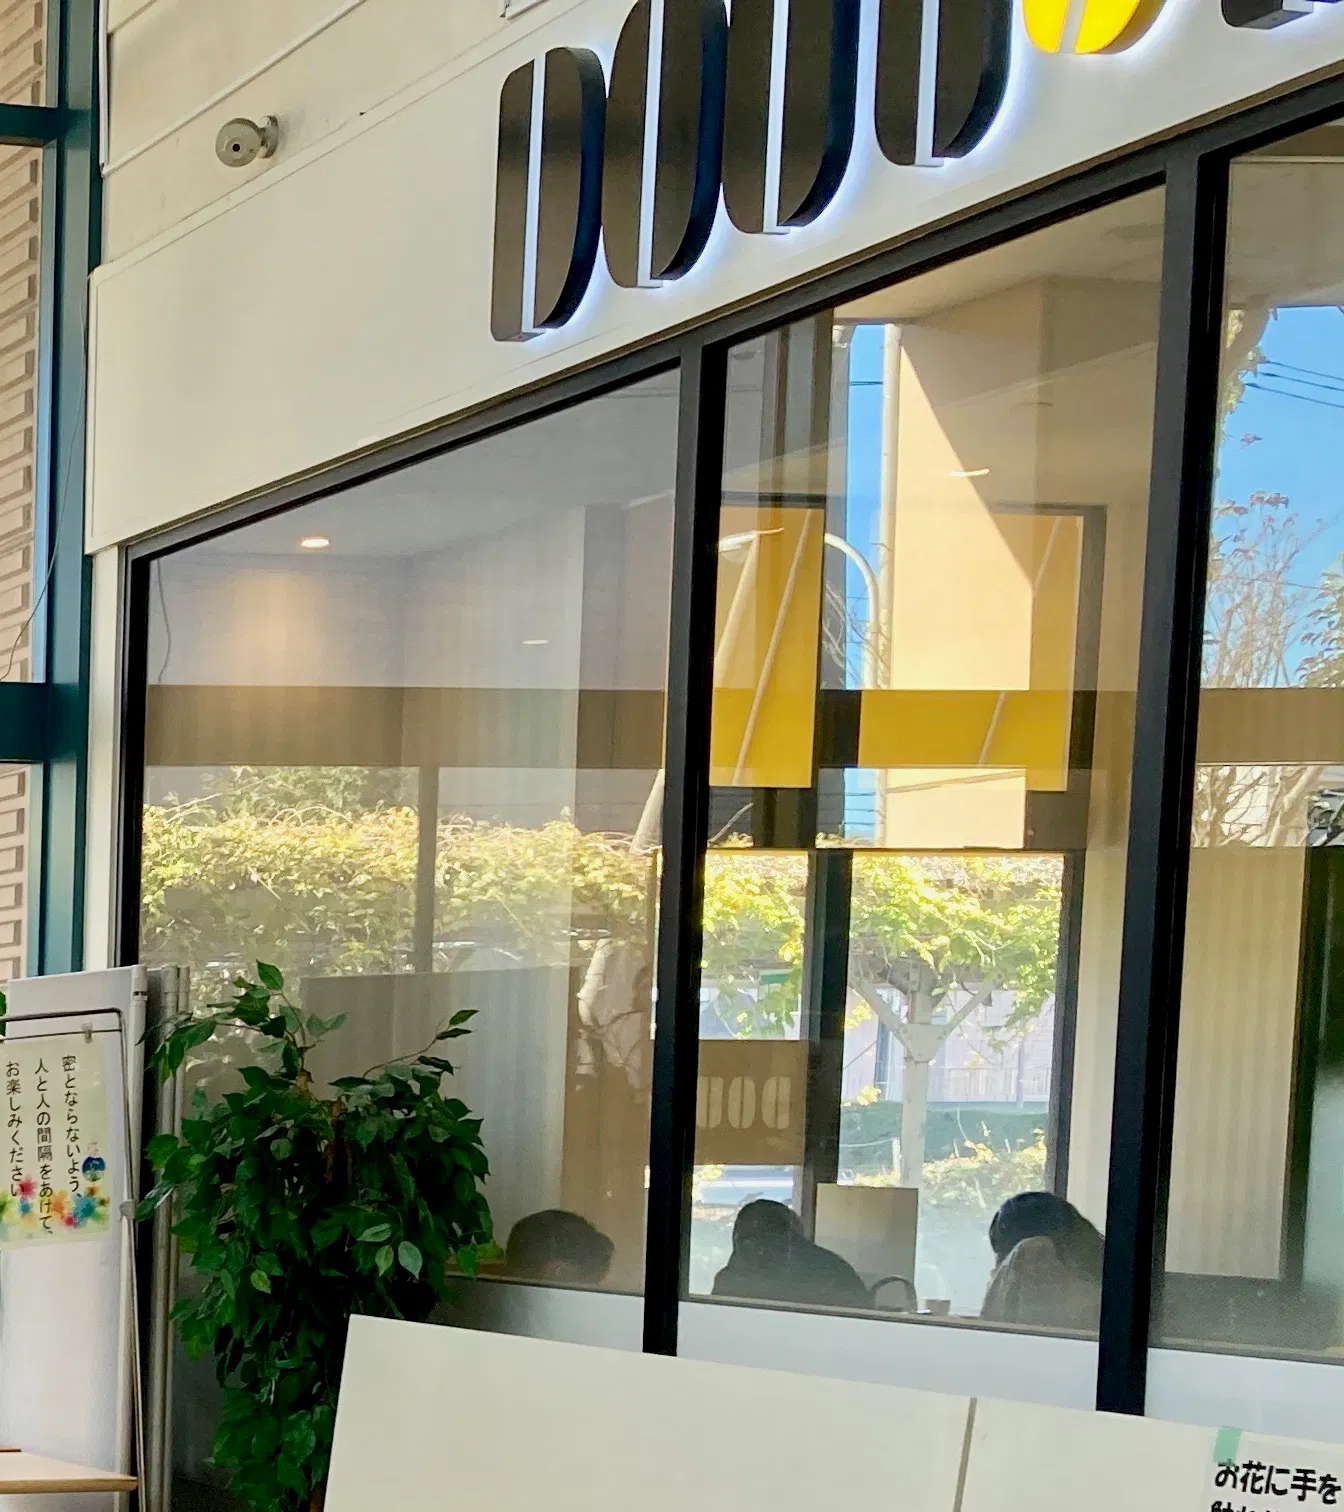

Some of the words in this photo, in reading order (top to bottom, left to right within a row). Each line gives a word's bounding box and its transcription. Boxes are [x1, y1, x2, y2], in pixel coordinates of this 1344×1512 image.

[5, 1061, 24, 1198] お楽しみください
[34, 1058, 54, 1236] 人と人の間隔をあけて、
[61, 1055, 82, 1198] 密とならないよう、
[1214, 1458, 1342, 1505] お花に手を
